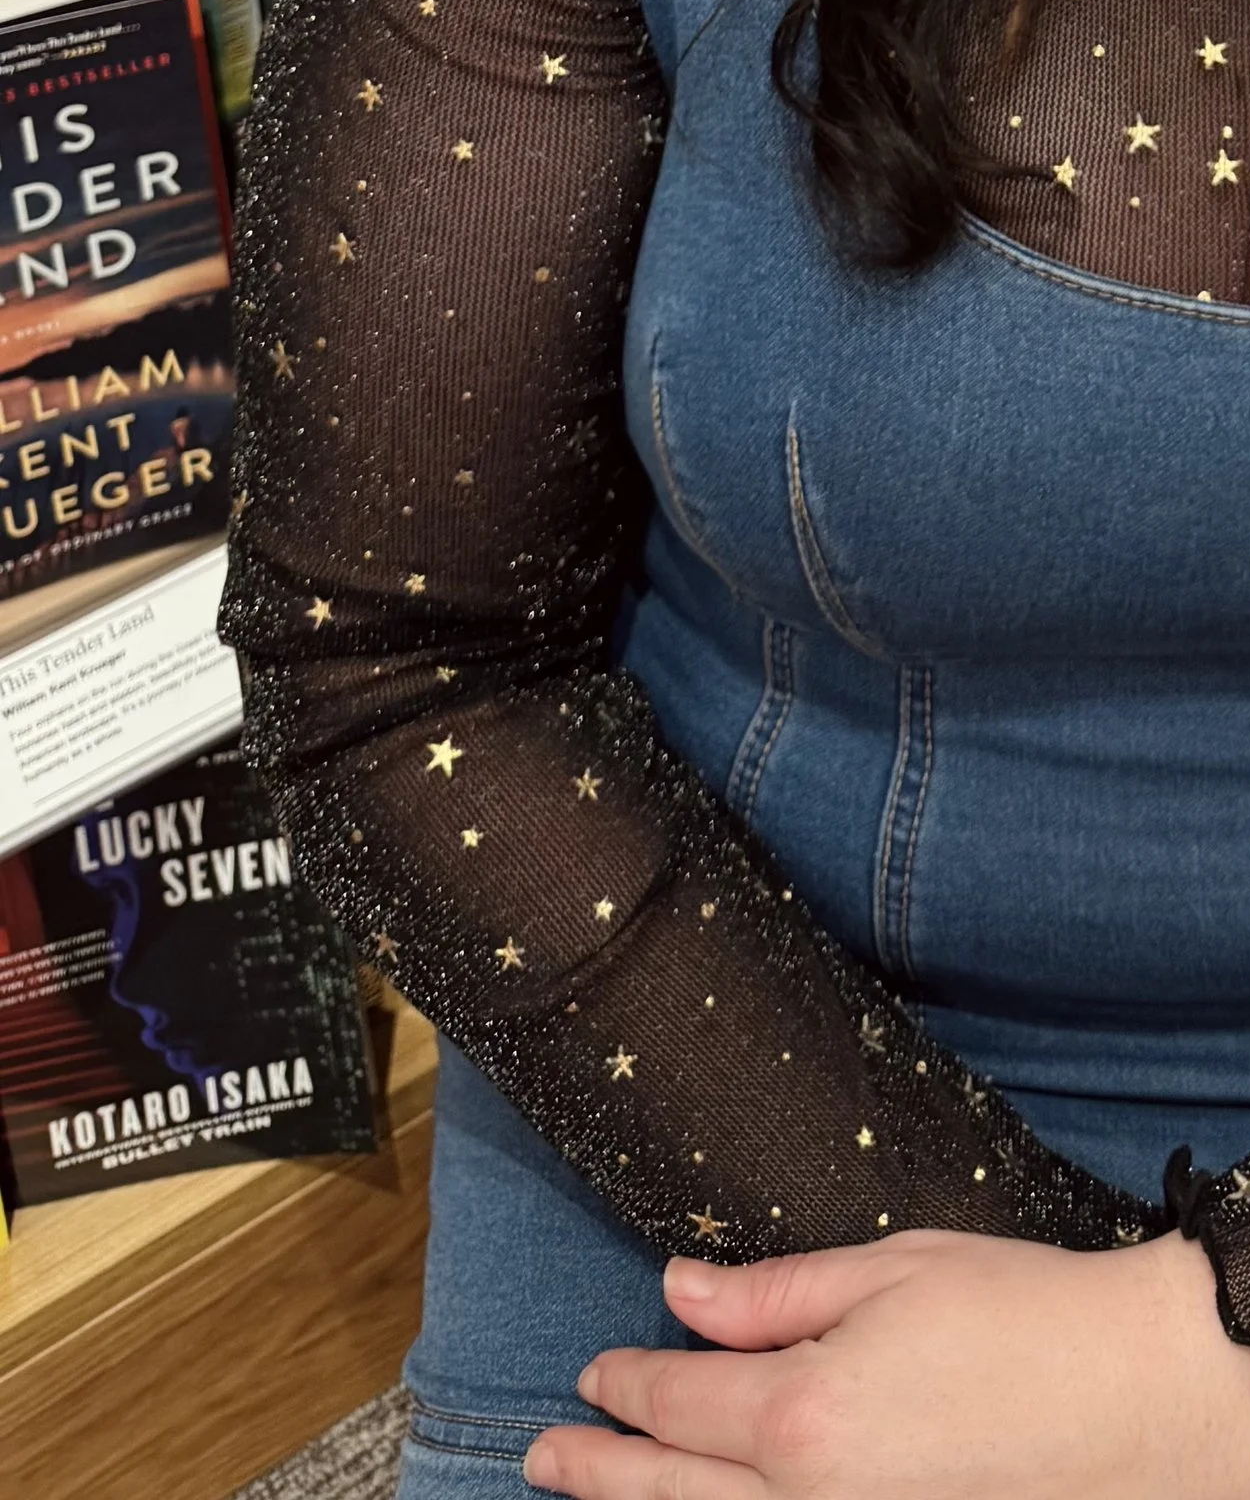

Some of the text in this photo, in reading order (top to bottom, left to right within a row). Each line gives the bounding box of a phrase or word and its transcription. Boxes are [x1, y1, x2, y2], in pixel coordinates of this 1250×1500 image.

[0, 603, 155, 697] This Tender Land
[2, 649, 127, 719] William Kent Krueger
[75, 796, 206, 874] LUCKY
[160, 837, 291, 907] SEVEN
[204, 1056, 313, 1114] ISAKA
[50, 1083, 191, 1158] KOTARO
[101, 1115, 272, 1169] BULLET TRAIN
